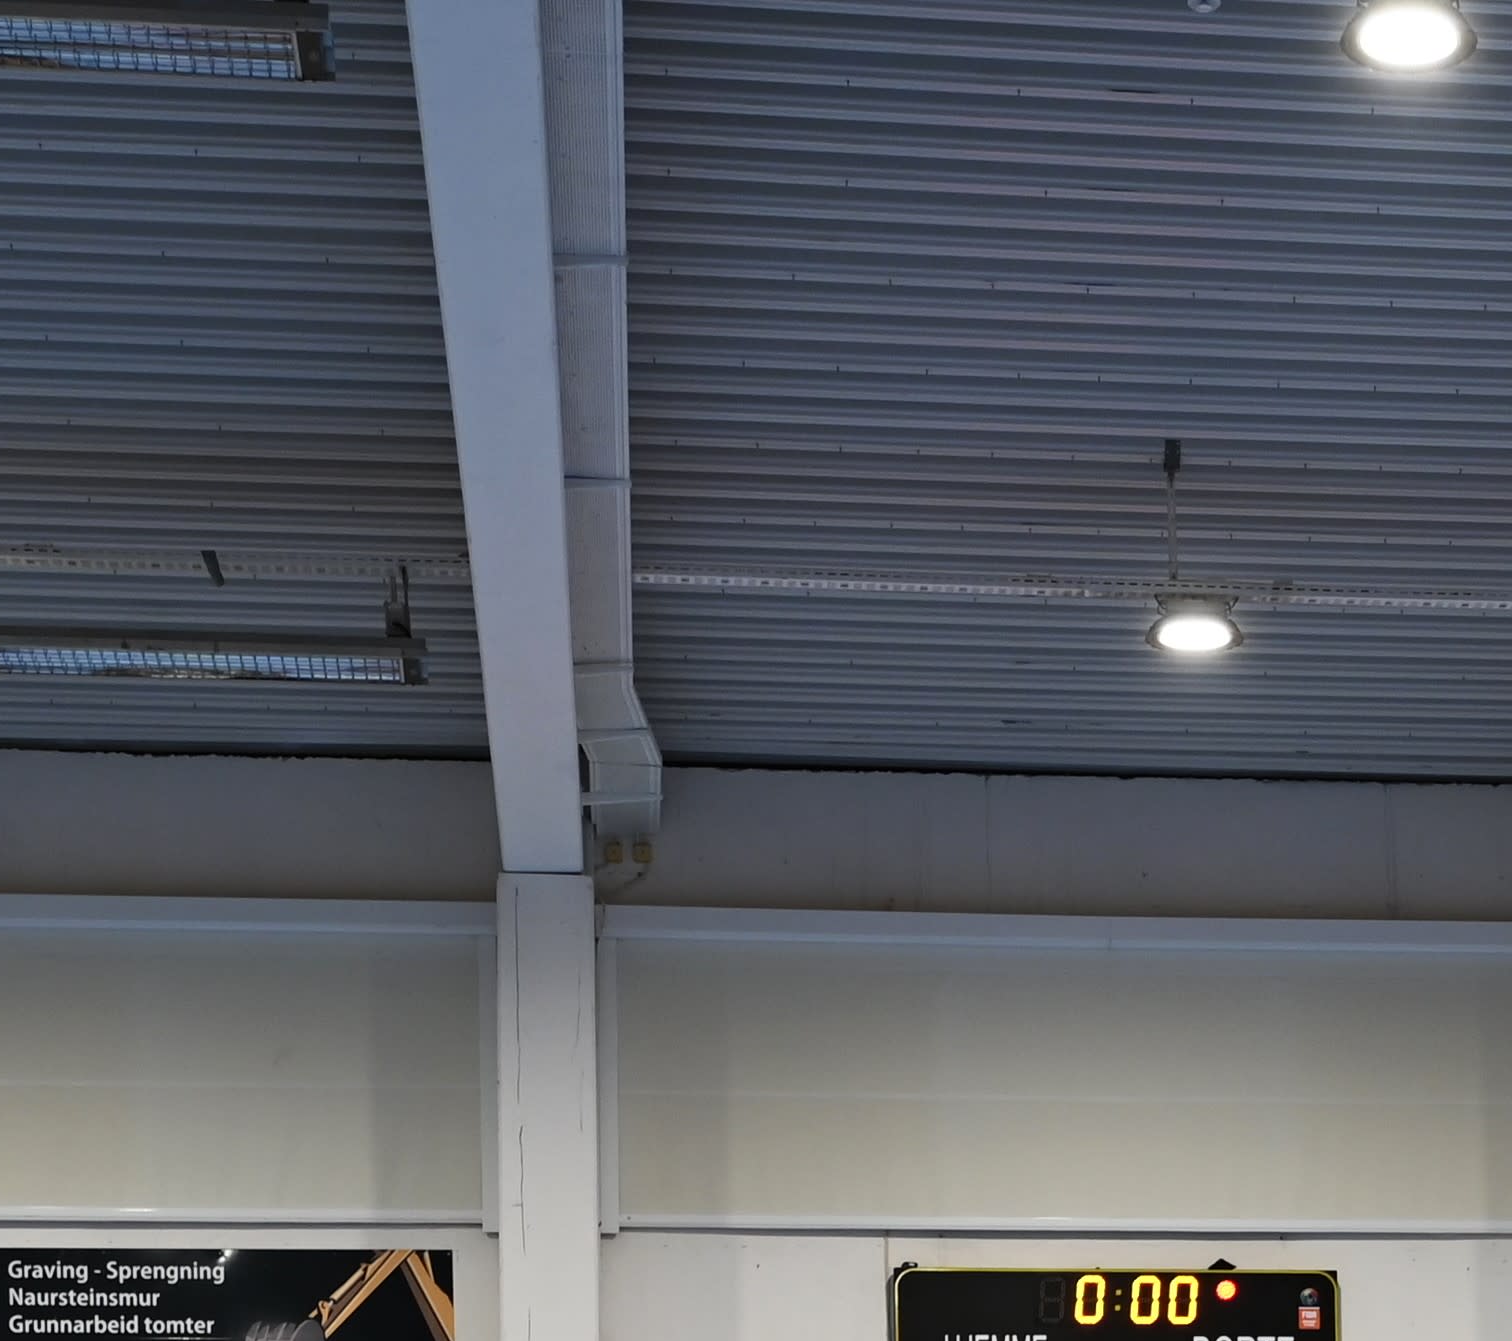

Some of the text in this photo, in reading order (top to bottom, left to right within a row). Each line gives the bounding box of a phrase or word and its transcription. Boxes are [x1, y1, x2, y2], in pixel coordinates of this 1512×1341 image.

[8, 1260, 225, 1284] Graving Sprengning
[8, 1288, 160, 1308] Naursteinsmur
[1074, 1274, 1199, 1325] 0:00
[8, 1315, 215, 1335] Grunnarbeid tomter
